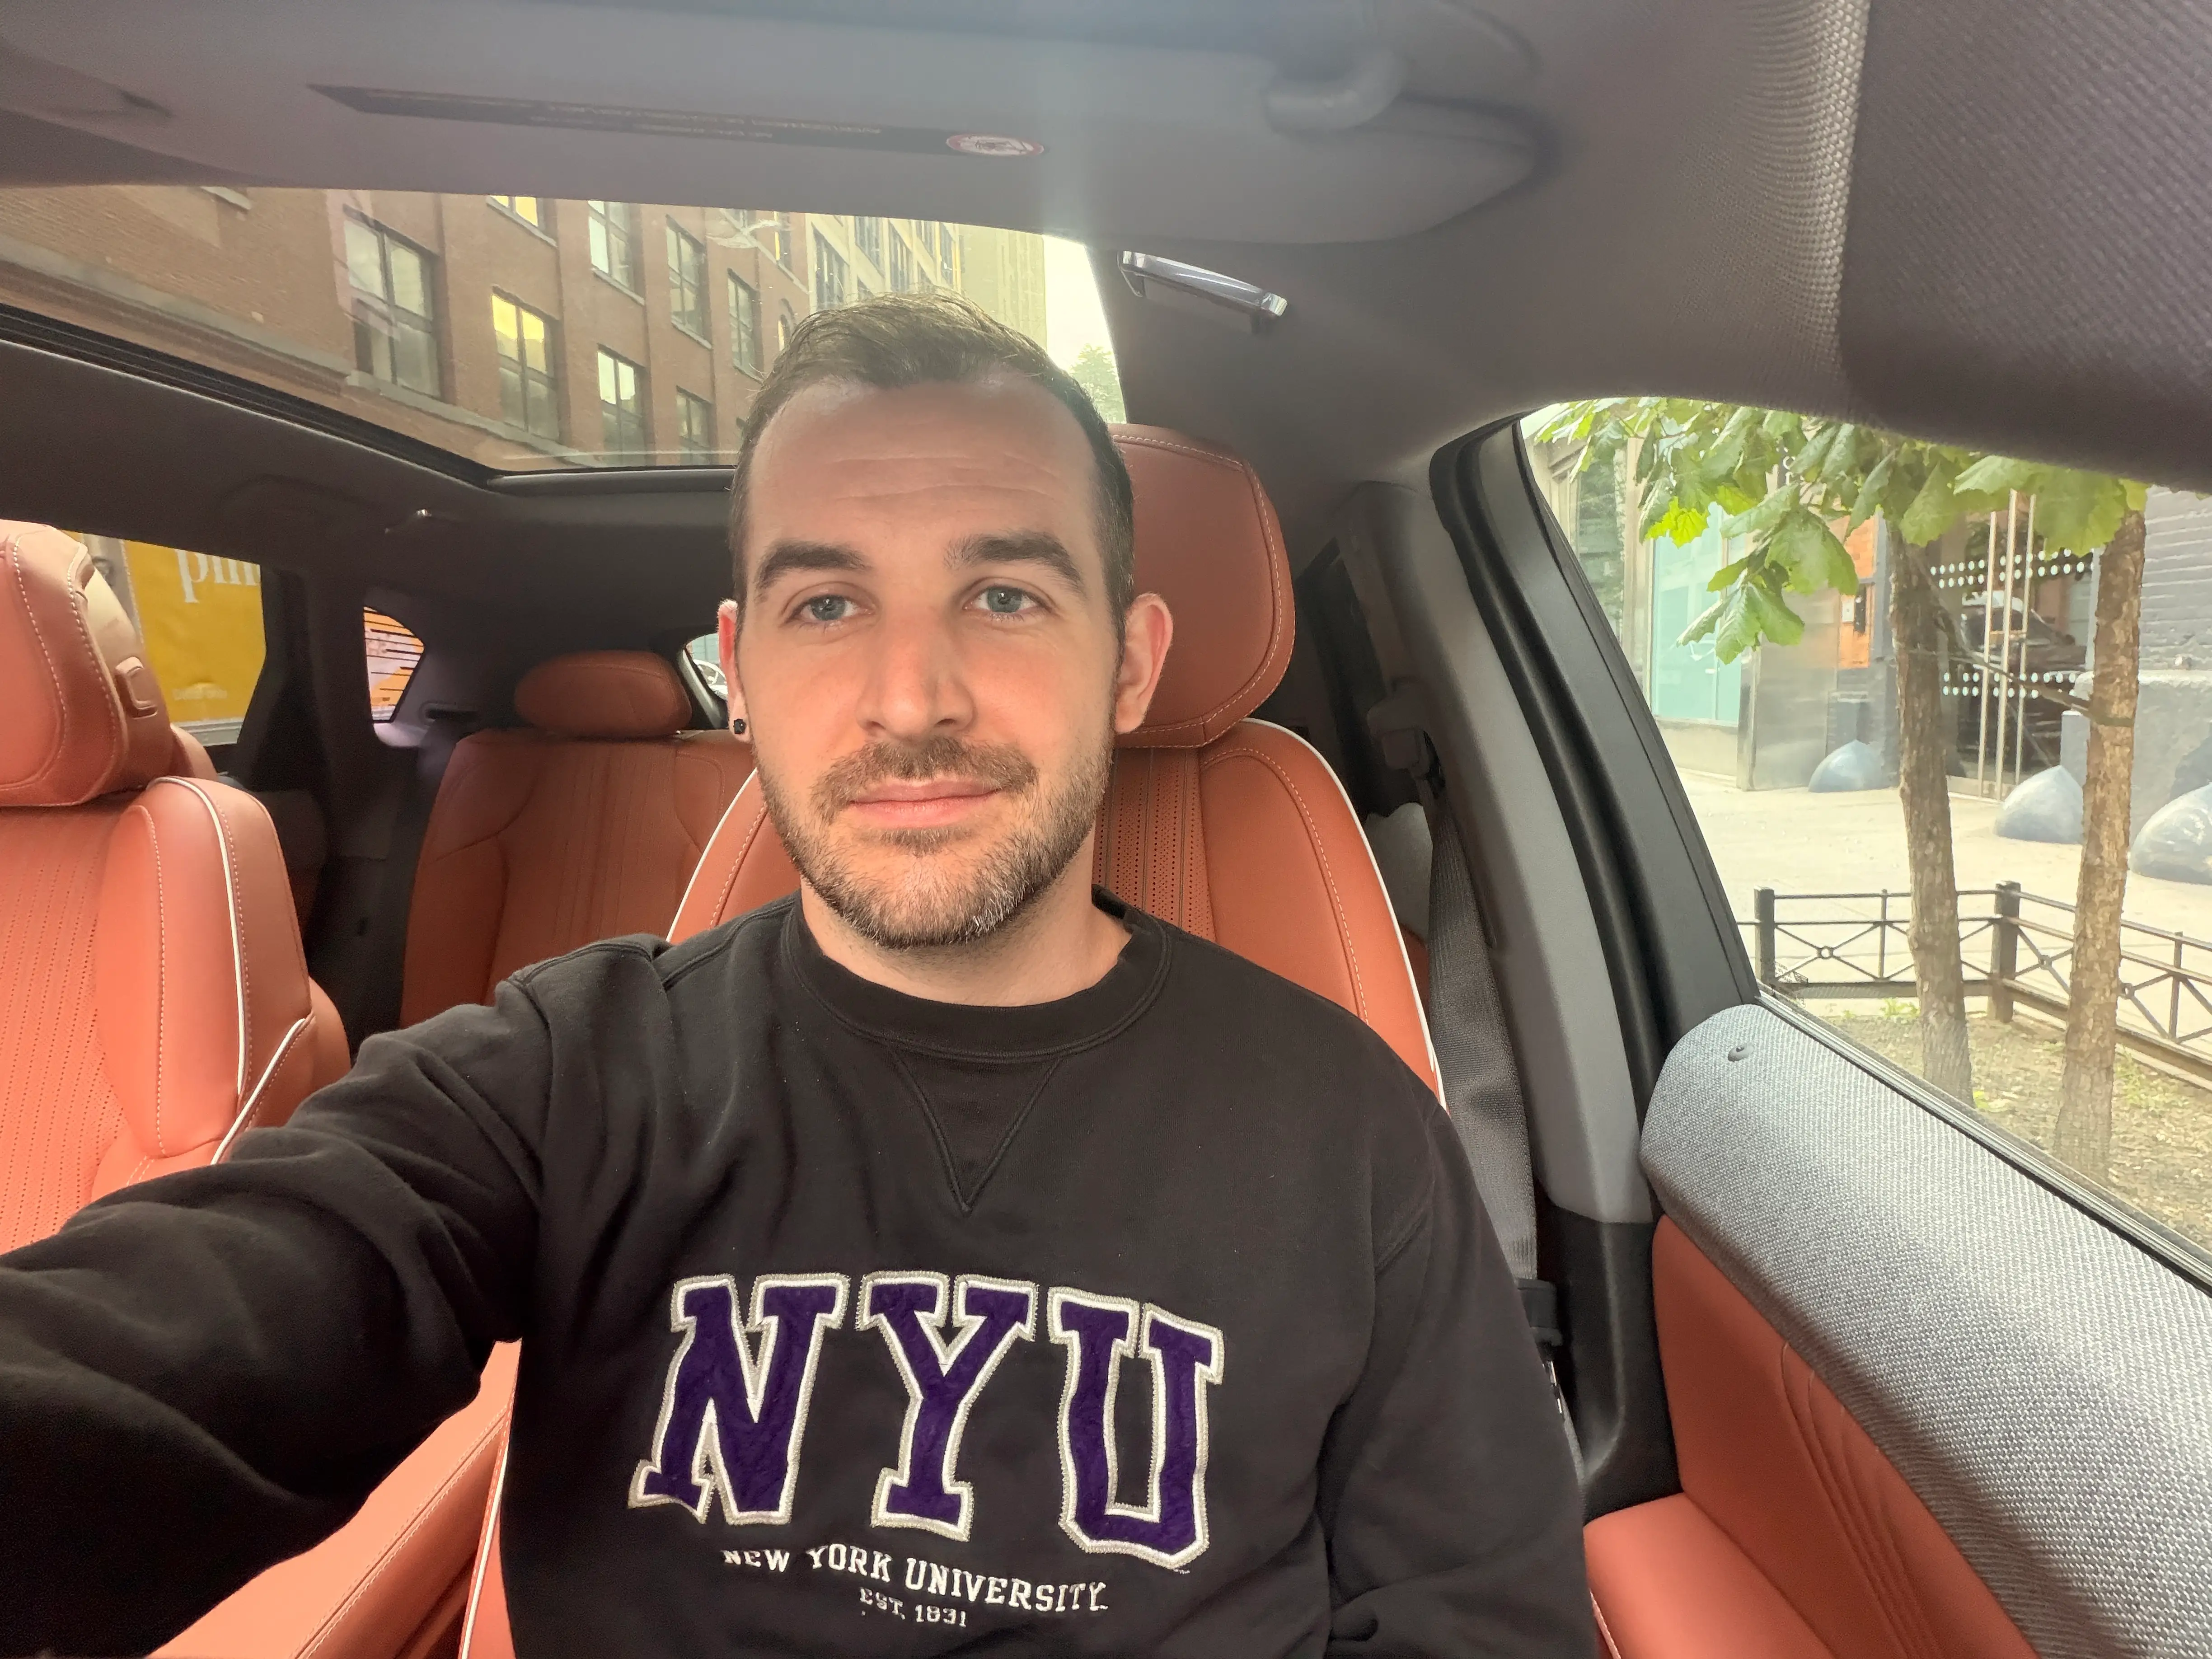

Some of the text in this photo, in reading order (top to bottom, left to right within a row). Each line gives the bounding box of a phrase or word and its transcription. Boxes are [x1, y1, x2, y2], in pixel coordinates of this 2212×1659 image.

[628, 1270, 1224, 1569] NYU
[722, 1549, 790, 1572] NEW
[806, 1543, 892, 1582] YORK
[915, 1604, 966, 1628] 1831
